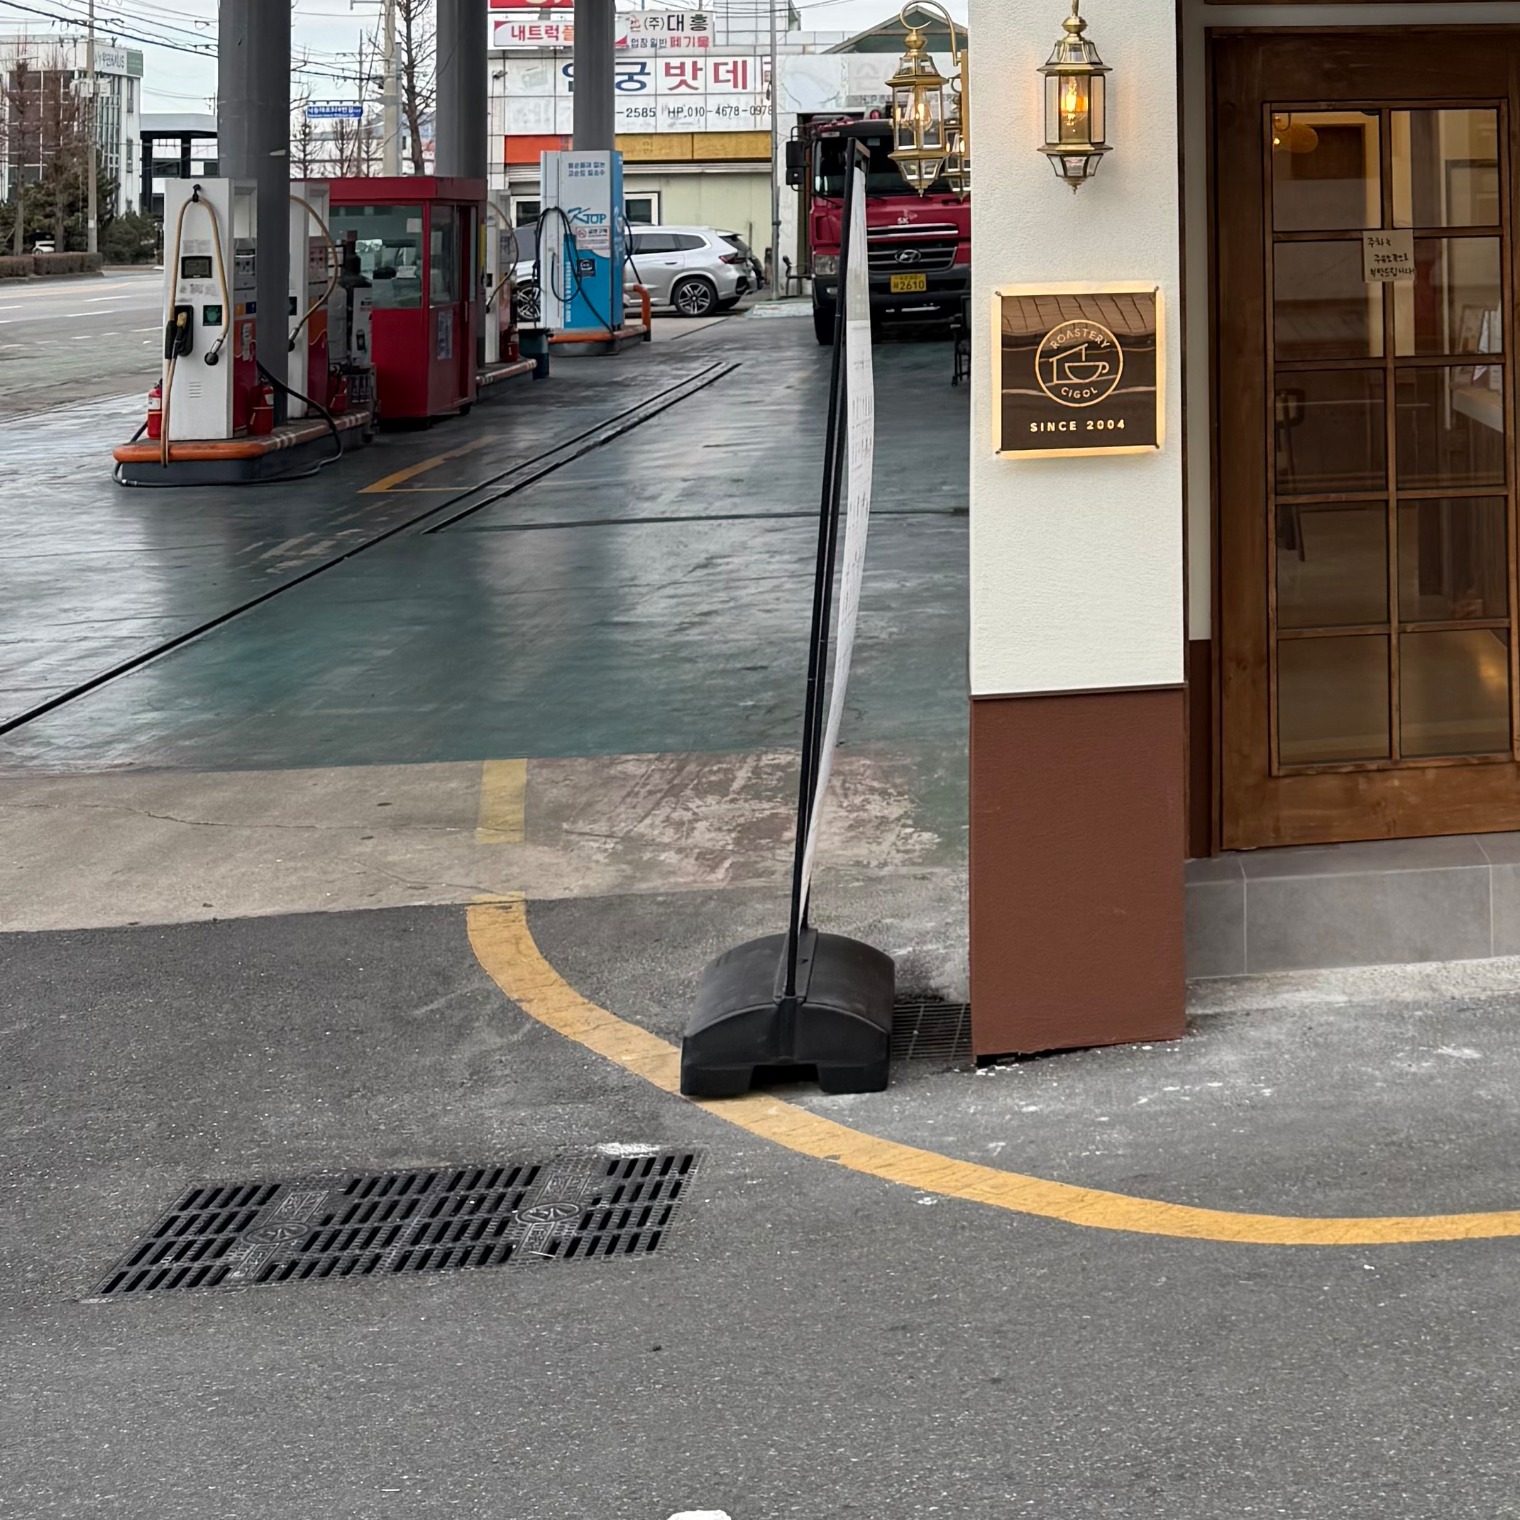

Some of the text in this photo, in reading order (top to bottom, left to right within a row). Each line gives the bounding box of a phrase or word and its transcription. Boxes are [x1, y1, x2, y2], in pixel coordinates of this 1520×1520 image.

[1050, 328, 1111, 350] ROASTERY
[1060, 386, 1098, 398] CIGOL
[1030, 419, 1126, 432] SINCE 2004
